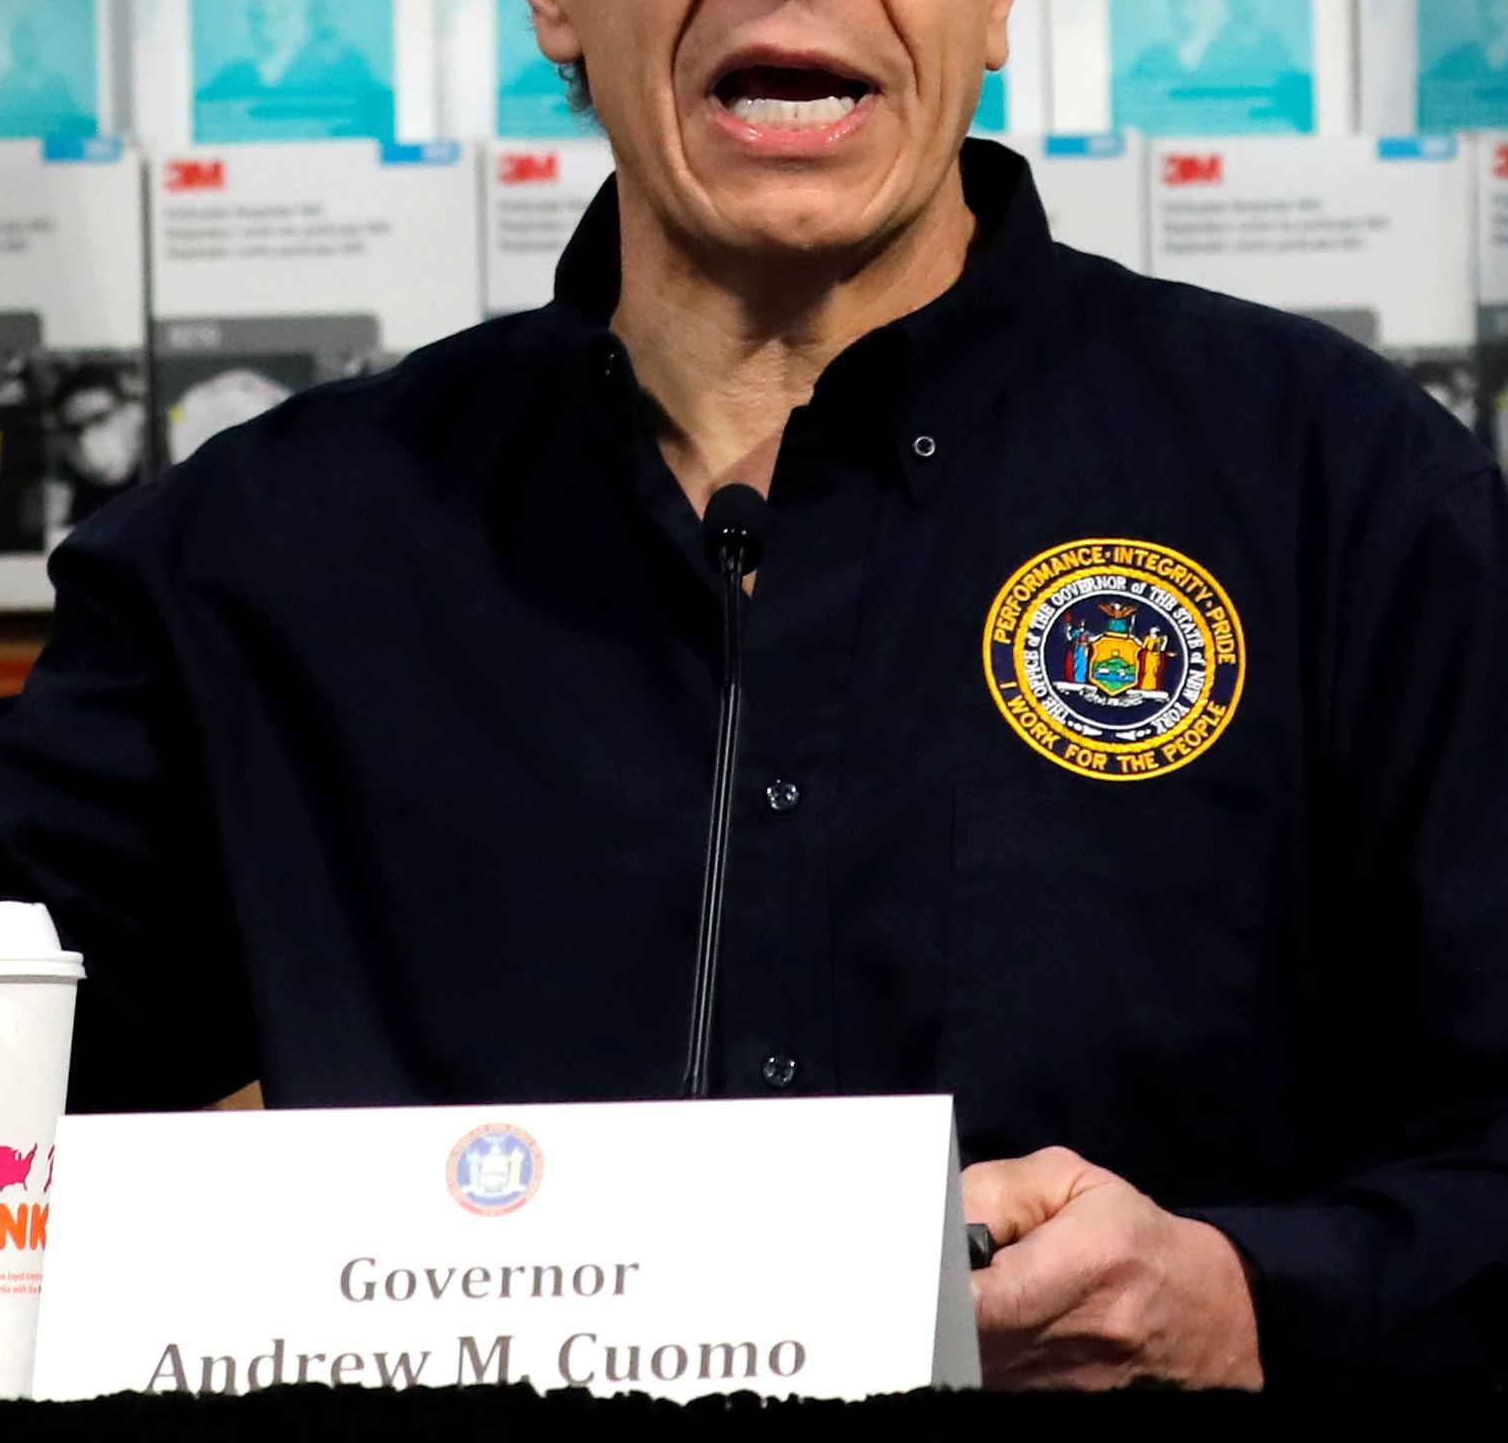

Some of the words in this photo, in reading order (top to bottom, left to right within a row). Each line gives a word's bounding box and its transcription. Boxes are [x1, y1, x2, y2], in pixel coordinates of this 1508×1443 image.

[994, 546, 1106, 645] PERFORMANCE
[1113, 546, 1213, 602] INTEGRITY
[1207, 607, 1237, 665] PRIDE
[1050, 575, 1127, 606] GOVERNOR
[1007, 694, 1063, 750] WORK
[1064, 744, 1108, 770] FOR
[1116, 752, 1160, 773] THE
[1162, 701, 1226, 763] PEOPLE
[340, 1256, 641, 1303] Governor
[142, 1338, 433, 1396] Andrew
[558, 1332, 806, 1387] Cuomo
